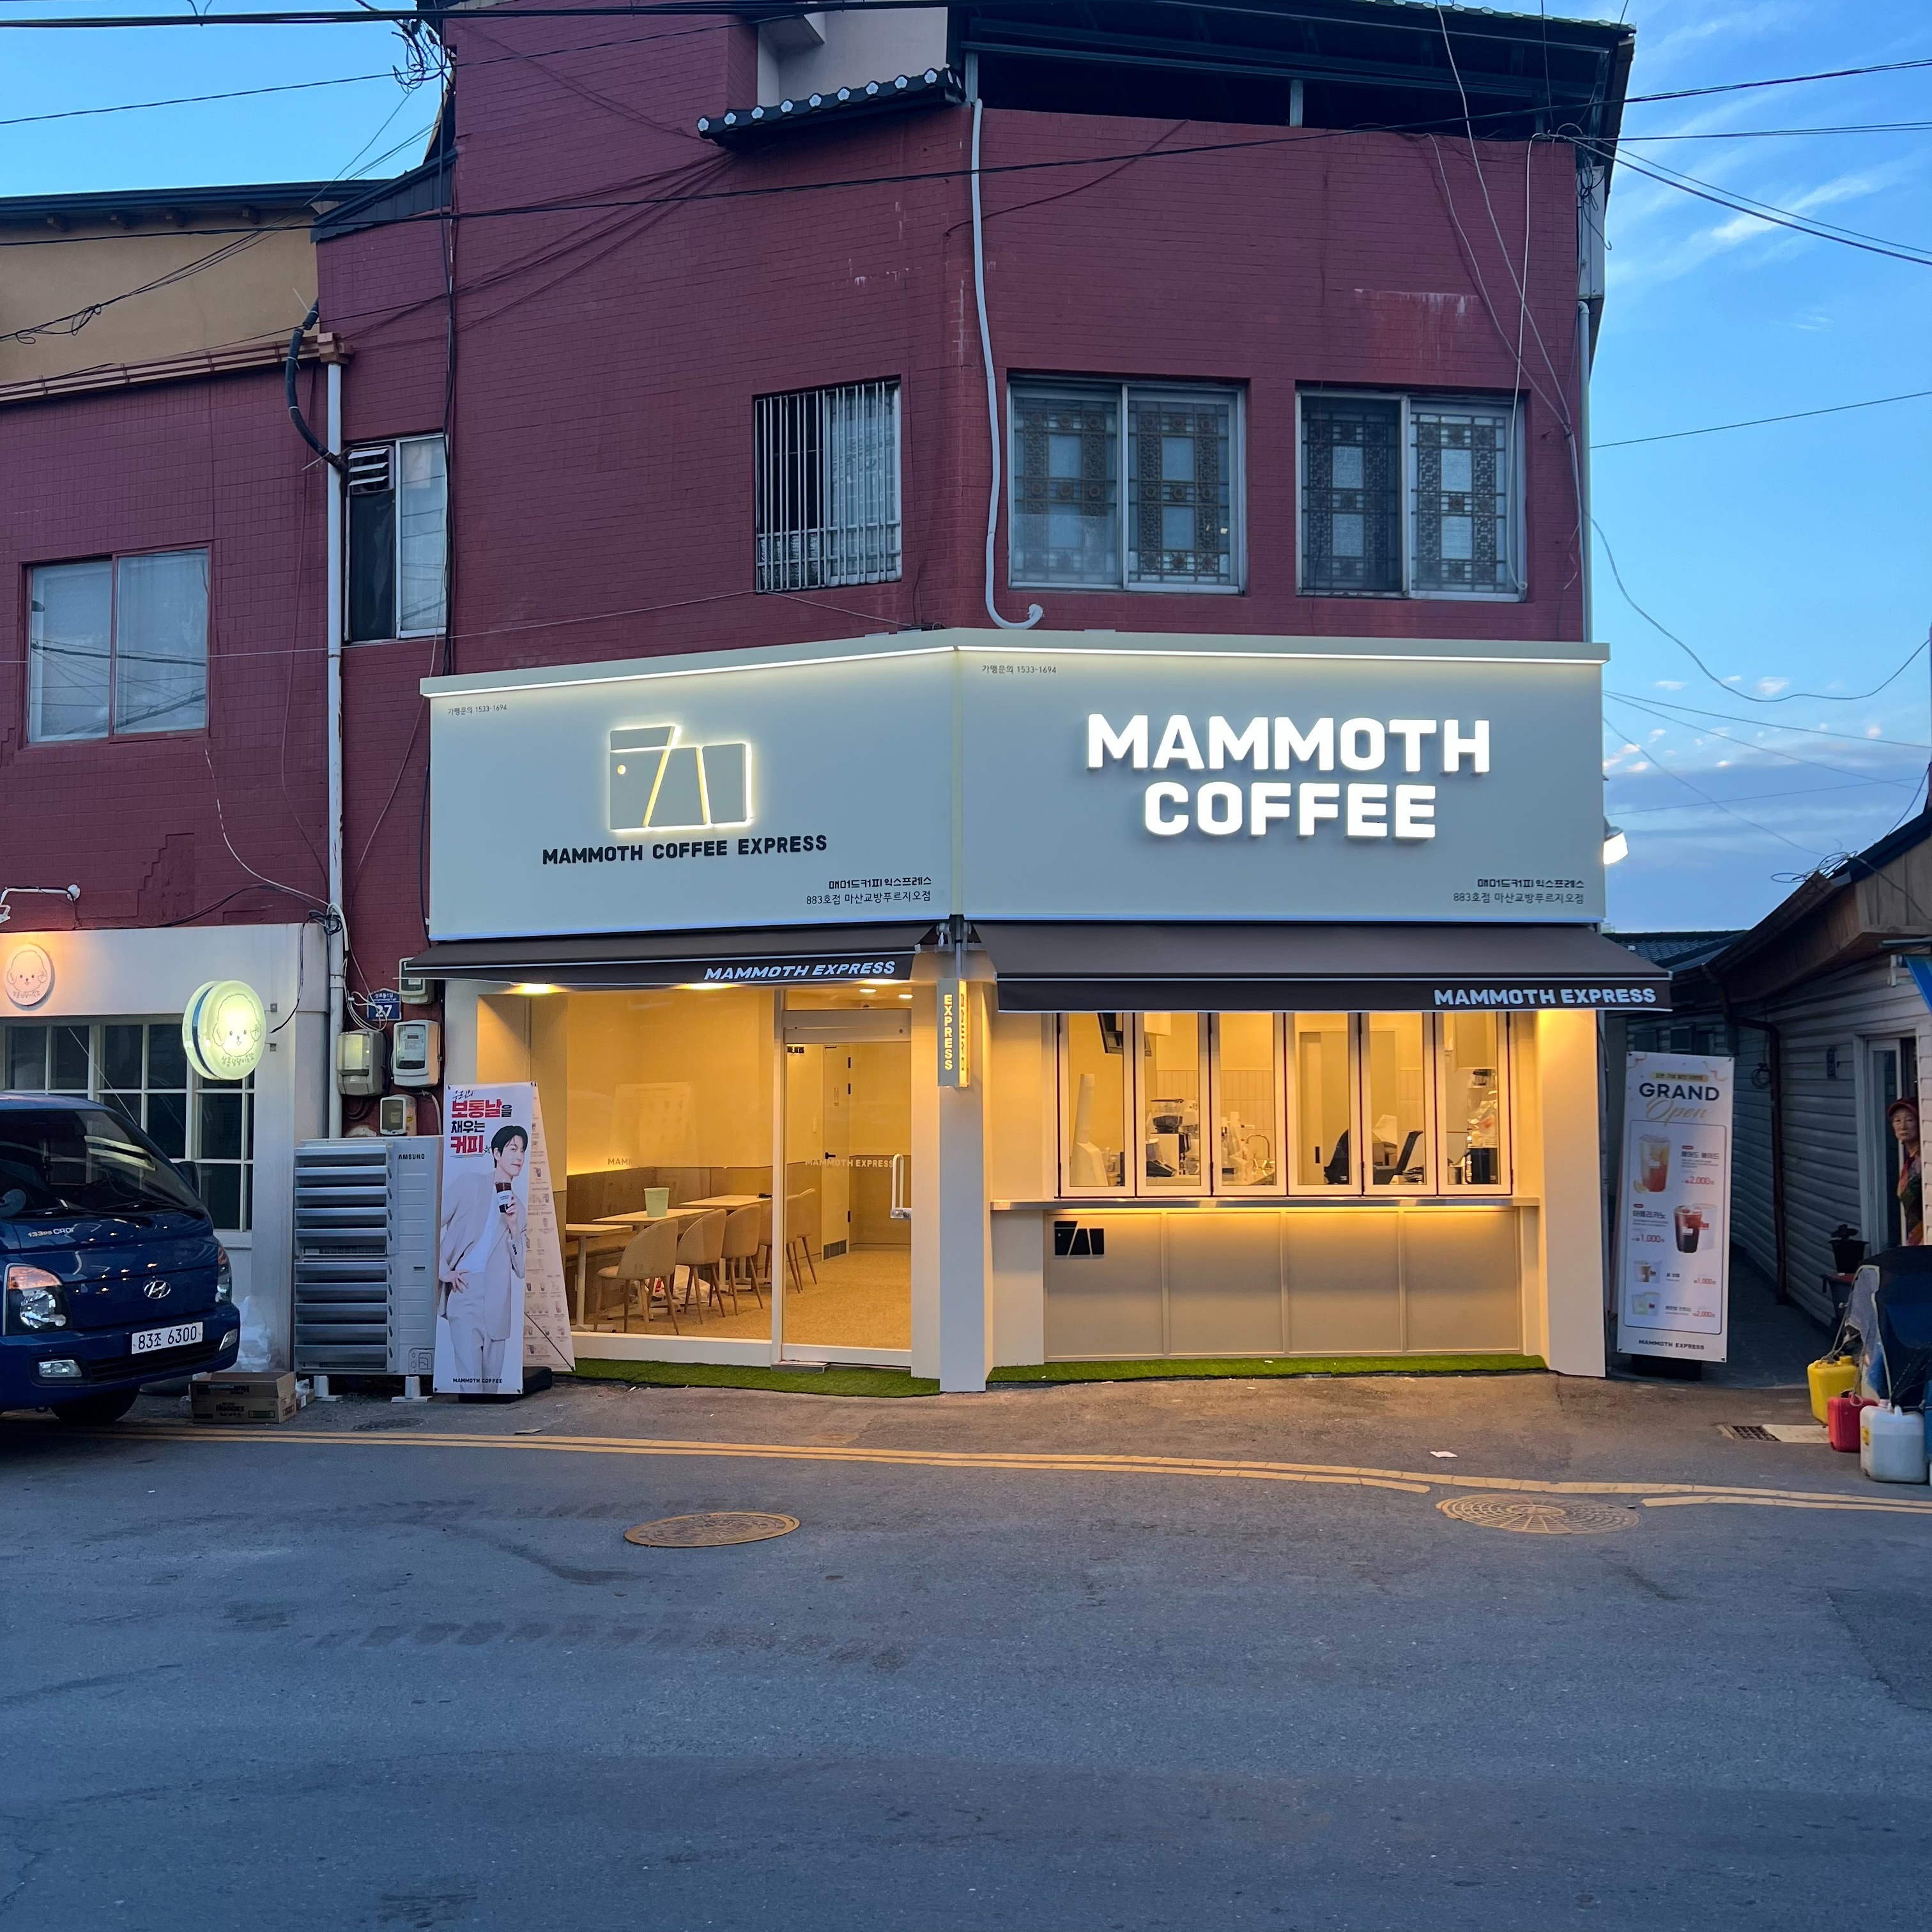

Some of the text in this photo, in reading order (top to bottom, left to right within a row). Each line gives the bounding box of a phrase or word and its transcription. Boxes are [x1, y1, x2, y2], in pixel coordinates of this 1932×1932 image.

[982, 665, 1013, 674] 가맹문의
[448, 704, 507, 716] 가맹문의 1533-1694
[1087, 714, 1490, 773] MAMMOTH
[1145, 781, 1436, 839] COFFEE
[542, 834, 828, 864] MAMMOTH COFFEE EXPRESS
[806, 891, 931, 905] 883호점 마산교방푸르지오점
[1453, 893, 1584, 904] 883호점 마산교방푸르지오점
[704, 961, 895, 980] MAMMOTH EXPRESS
[1434, 988, 1657, 1005] MAMMOTH EXPRESS
[375, 1004, 392, 1017] 27
[943, 994, 953, 1070] EXPRESS
[1639, 1083, 1719, 1101] GRAND
[452, 1099, 512, 1118] 보통날을
[1646, 1096, 1707, 1127] Open
[451, 1120, 485, 1133] 채우는
[450, 1135, 483, 1153] 커피
[805, 1159, 893, 1167] MAMMOTH EXPRESS
[138, 1326, 197, 1350] 83조 6300
